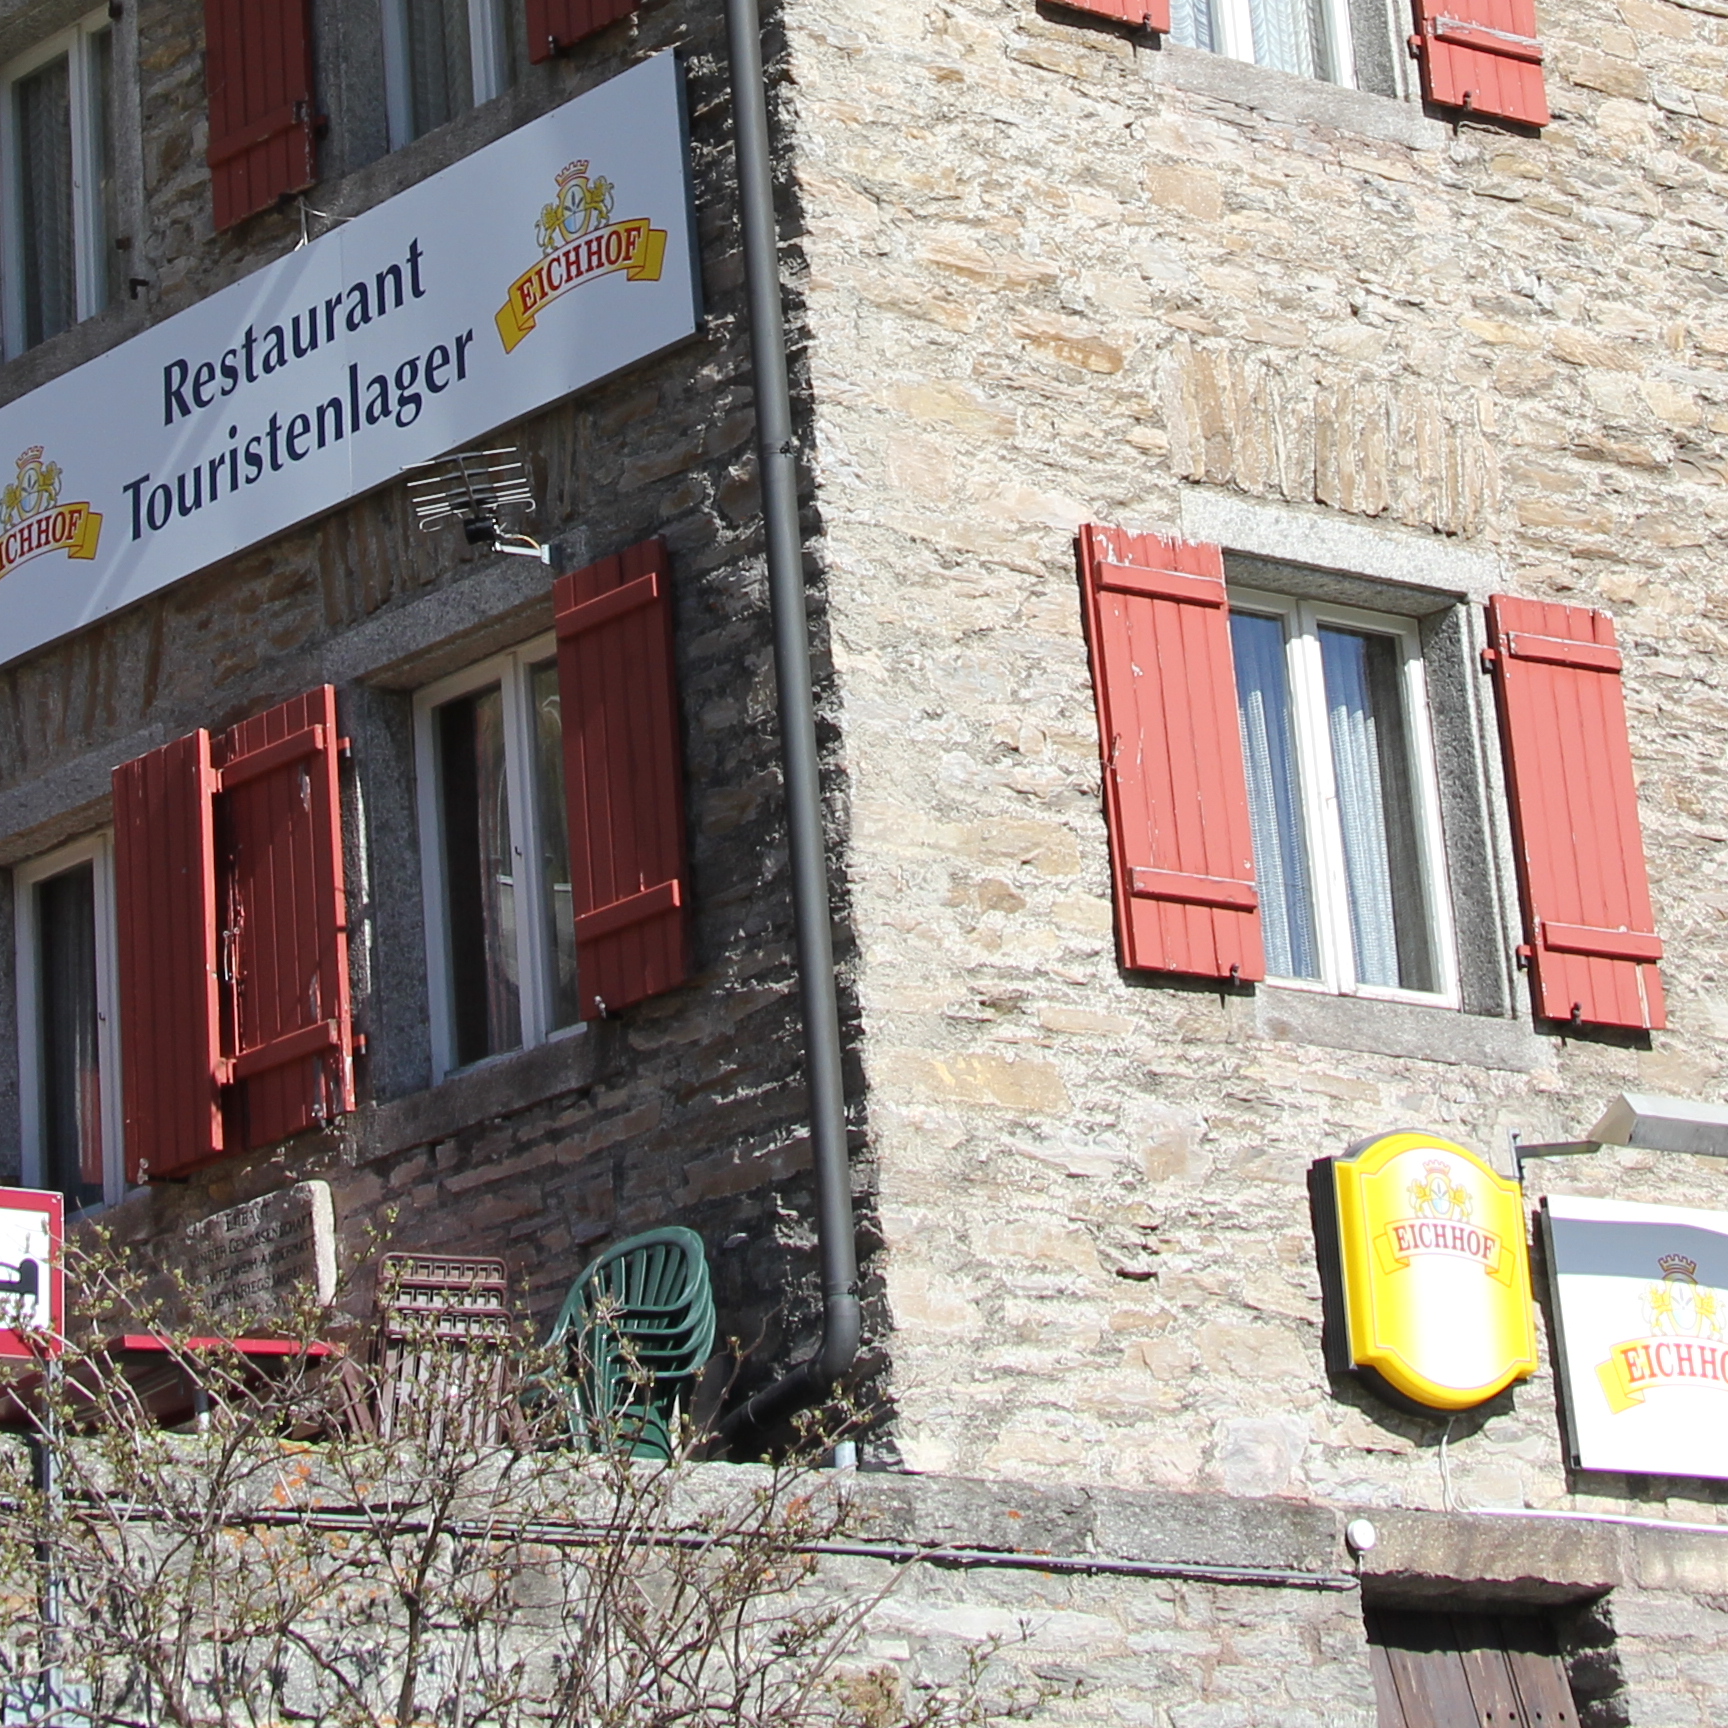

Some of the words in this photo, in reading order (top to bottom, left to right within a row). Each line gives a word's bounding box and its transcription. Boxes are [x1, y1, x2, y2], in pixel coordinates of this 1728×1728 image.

[162, 237, 427, 426] Restaurant
[516, 226, 642, 315] EICHHOF
[122, 328, 474, 542] Touristenlager
[1392, 1222, 1496, 1261] EICHHOF
